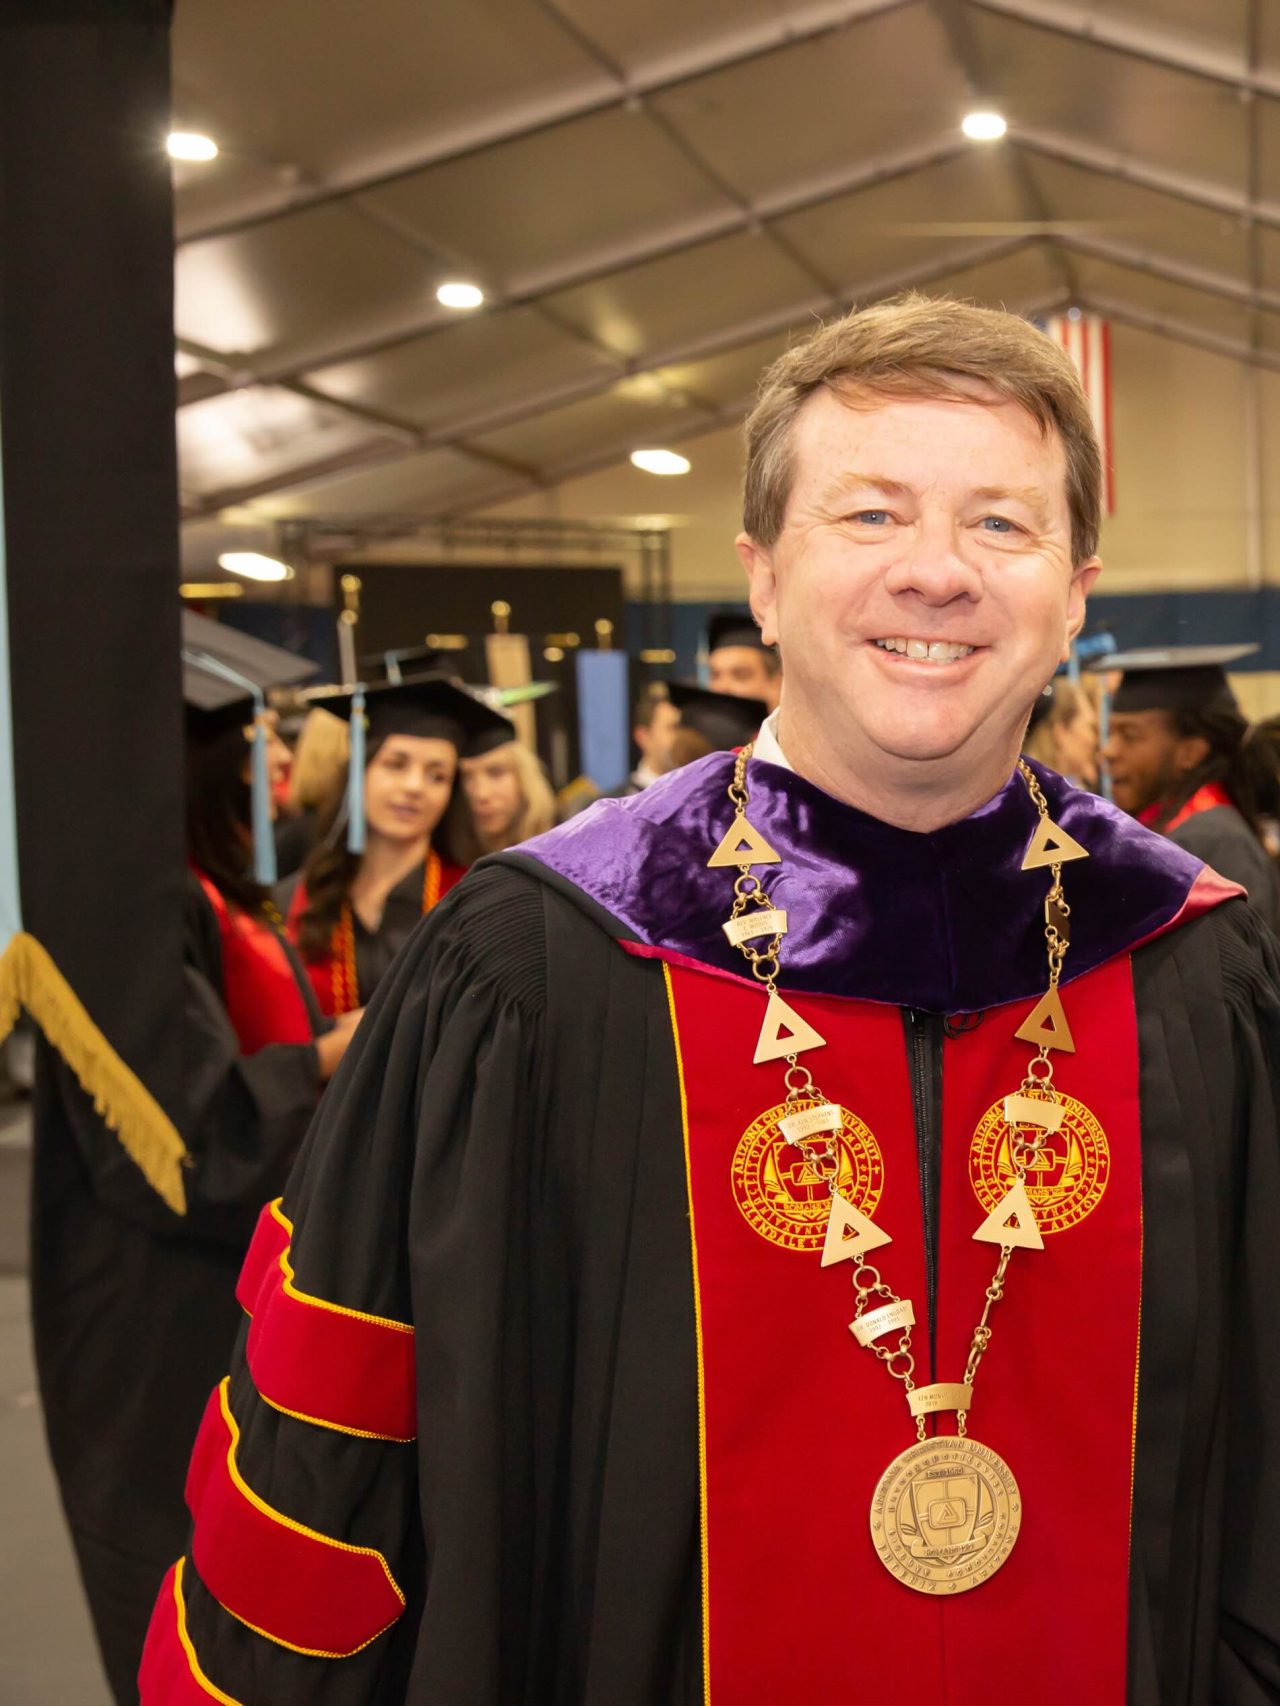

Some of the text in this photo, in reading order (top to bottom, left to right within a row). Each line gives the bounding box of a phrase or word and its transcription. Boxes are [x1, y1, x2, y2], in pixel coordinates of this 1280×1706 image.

[734, 1122, 764, 1175] ARIZONA
[840, 1110, 880, 1160] NIVERSITY
[972, 1105, 1003, 1154] ARIZONA
[1065, 1098, 1109, 1156] UNIVERSITY
[741, 1199, 806, 1248] GLENDALE
